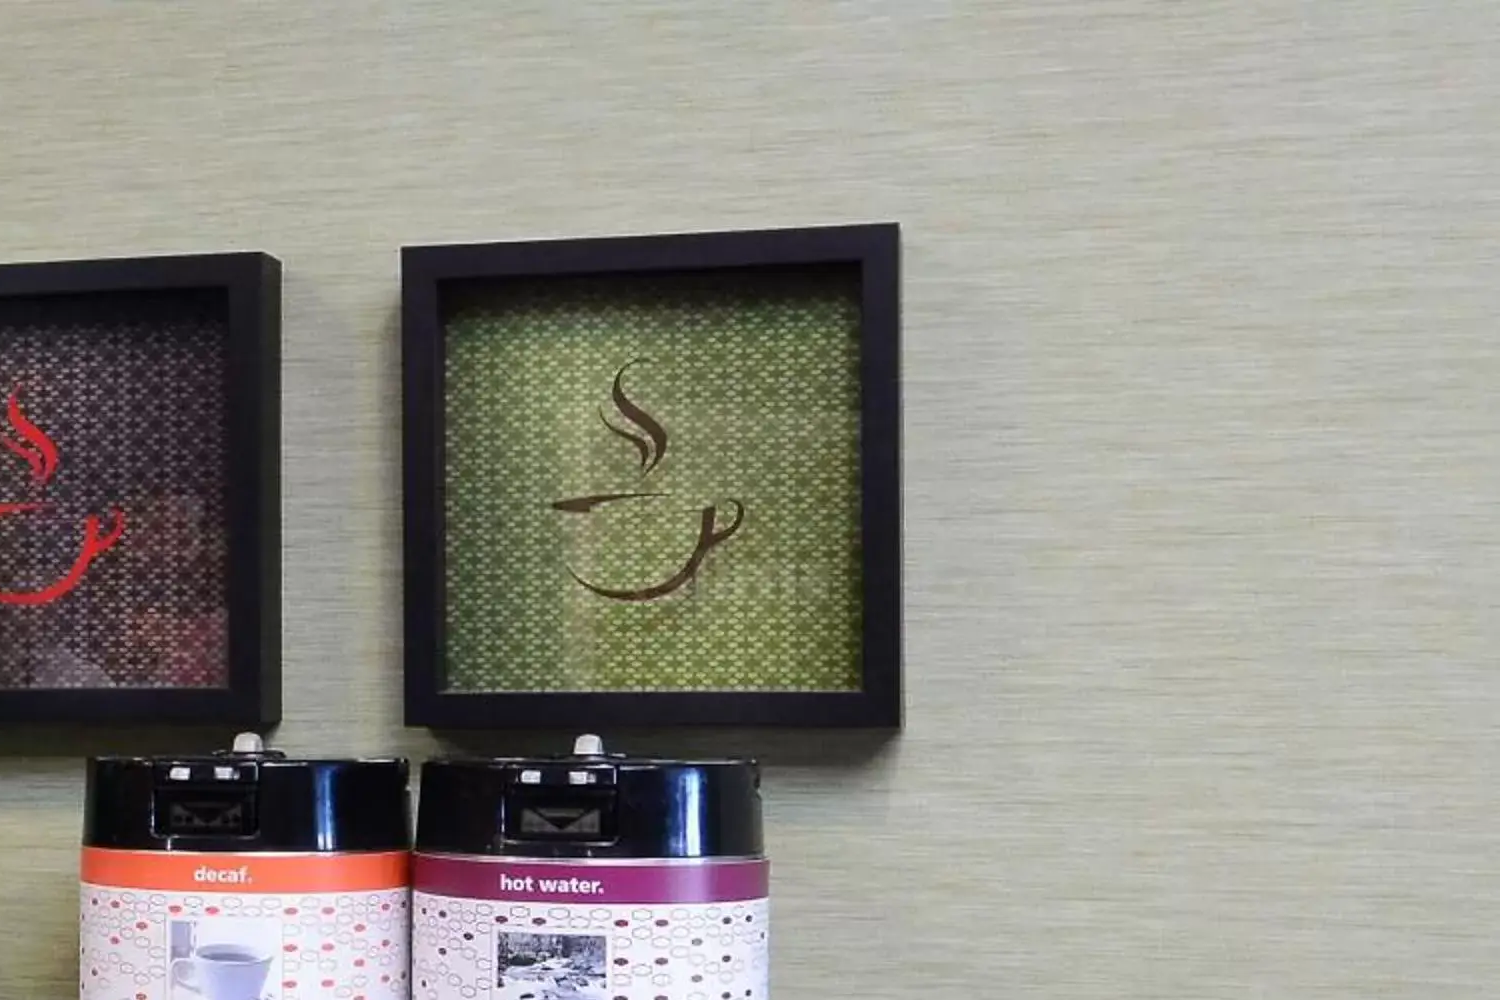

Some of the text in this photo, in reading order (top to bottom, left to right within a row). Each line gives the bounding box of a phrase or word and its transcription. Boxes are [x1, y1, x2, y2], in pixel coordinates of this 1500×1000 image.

[194, 865, 253, 884] decaf.
[500, 873, 605, 894] hot water.
